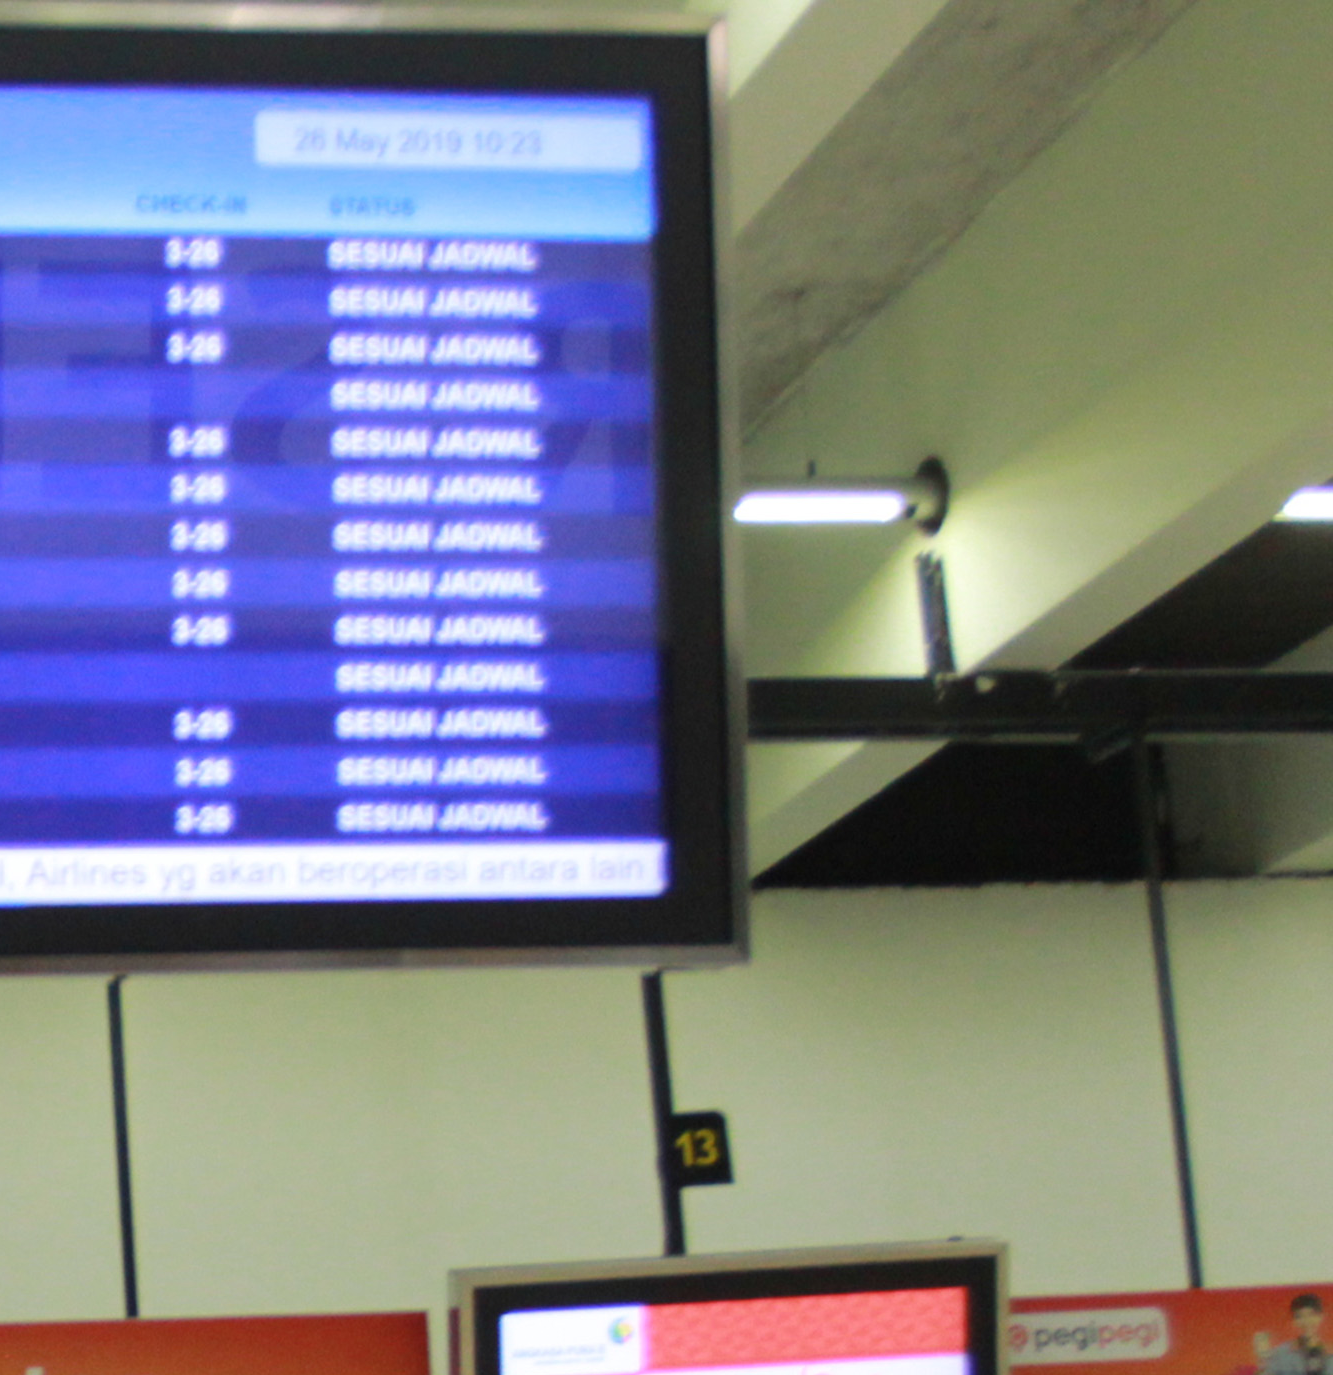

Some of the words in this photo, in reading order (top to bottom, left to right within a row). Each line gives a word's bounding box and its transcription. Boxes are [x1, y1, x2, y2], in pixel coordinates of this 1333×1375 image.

[334, 127, 389, 157] May
[330, 380, 428, 410] SESUAI
[334, 568, 431, 598] SESUAI
[27, 858, 146, 888] Airlines
[208, 857, 285, 884] akan
[299, 856, 468, 889] beroperasi
[479, 857, 579, 883] antara
[674, 1128, 720, 1168] 13
[1034, 1321, 1160, 1350] pegipegi
